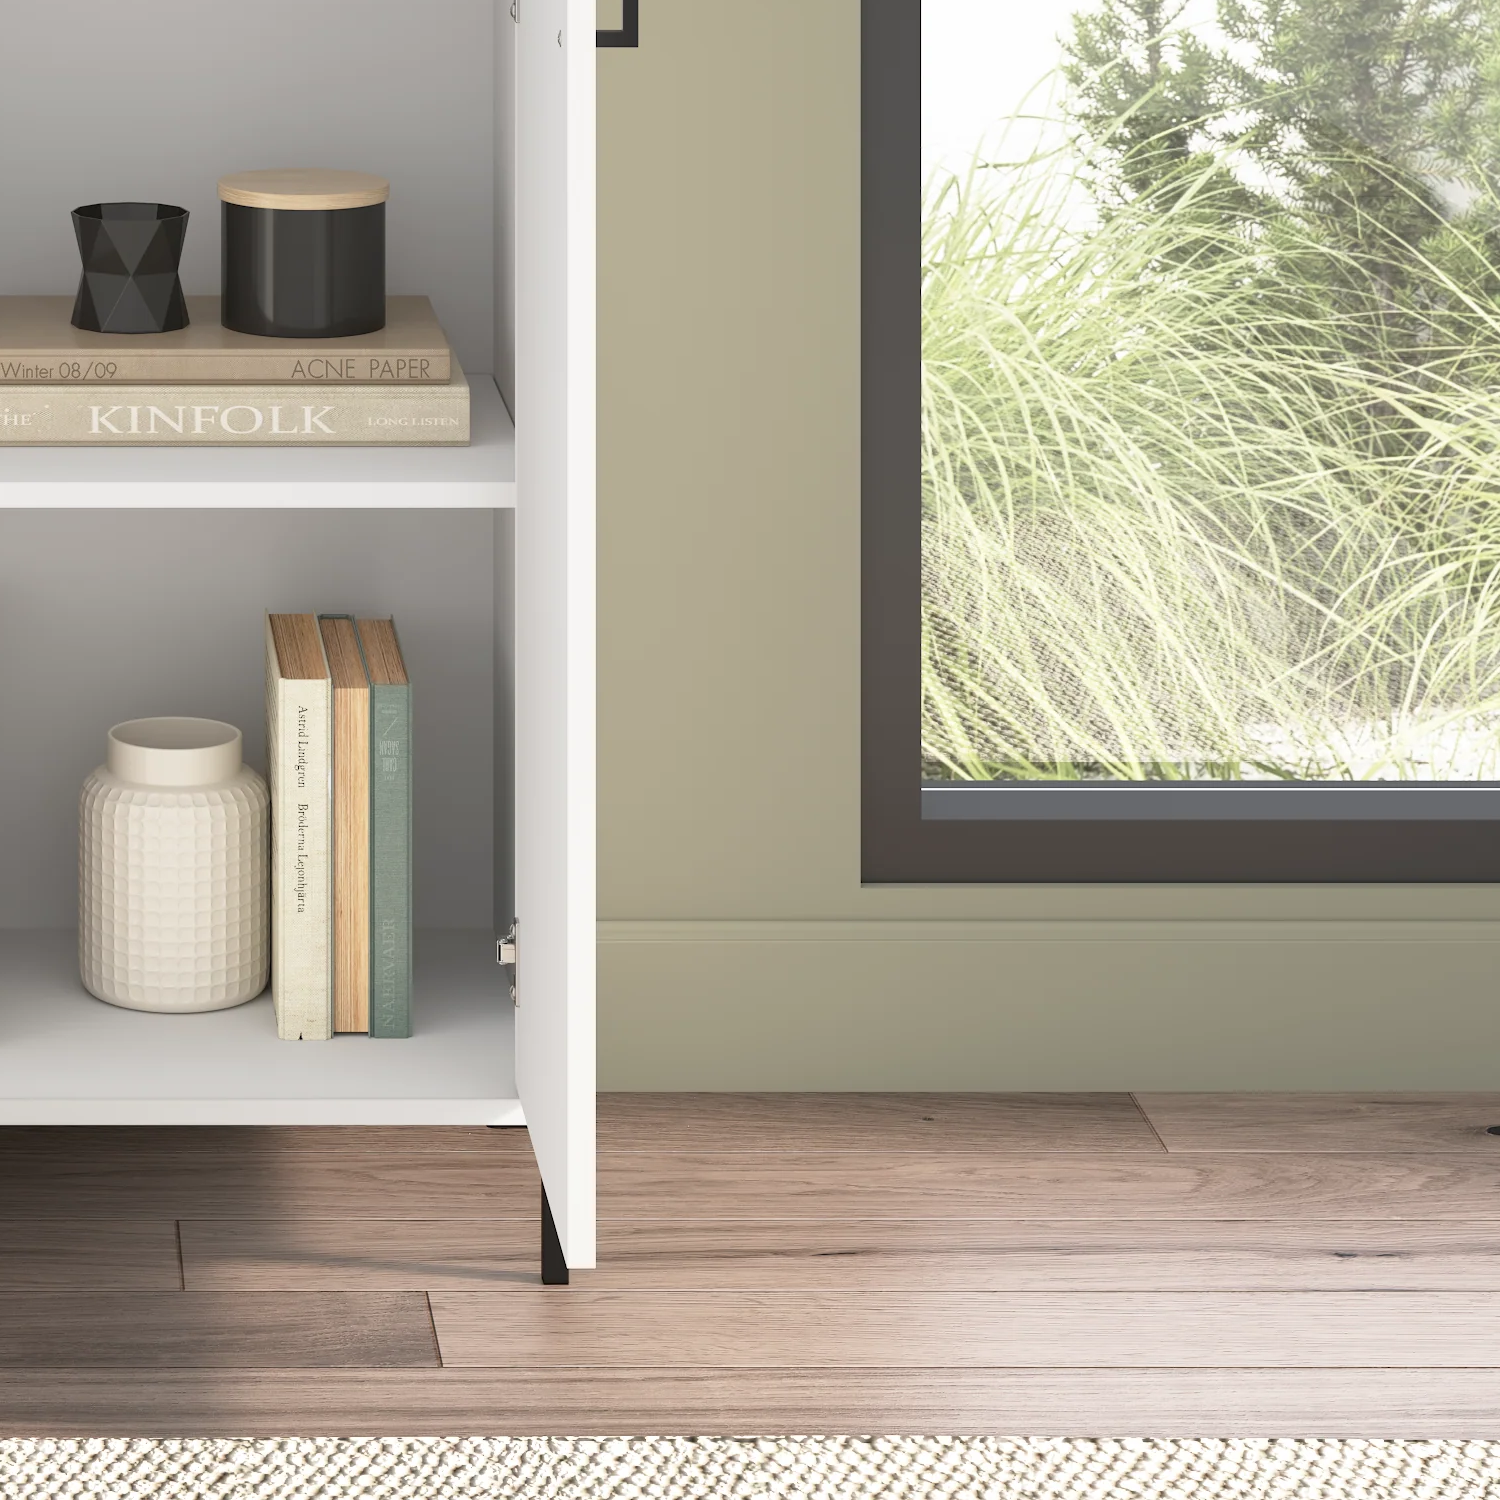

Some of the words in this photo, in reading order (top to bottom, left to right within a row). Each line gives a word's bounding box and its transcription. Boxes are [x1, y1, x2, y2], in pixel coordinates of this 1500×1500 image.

[1, 361, 54, 379] Winter
[59, 361, 118, 381] 08/09
[291, 358, 356, 379] ACNE
[369, 358, 431, 379] PAPER
[88, 405, 336, 434] KINFOLK
[368, 417, 408, 426] LONG
[298, 706, 308, 738] Astrid
[294, 741, 308, 788] Lindgren
[297, 803, 308, 851] Bröderna
